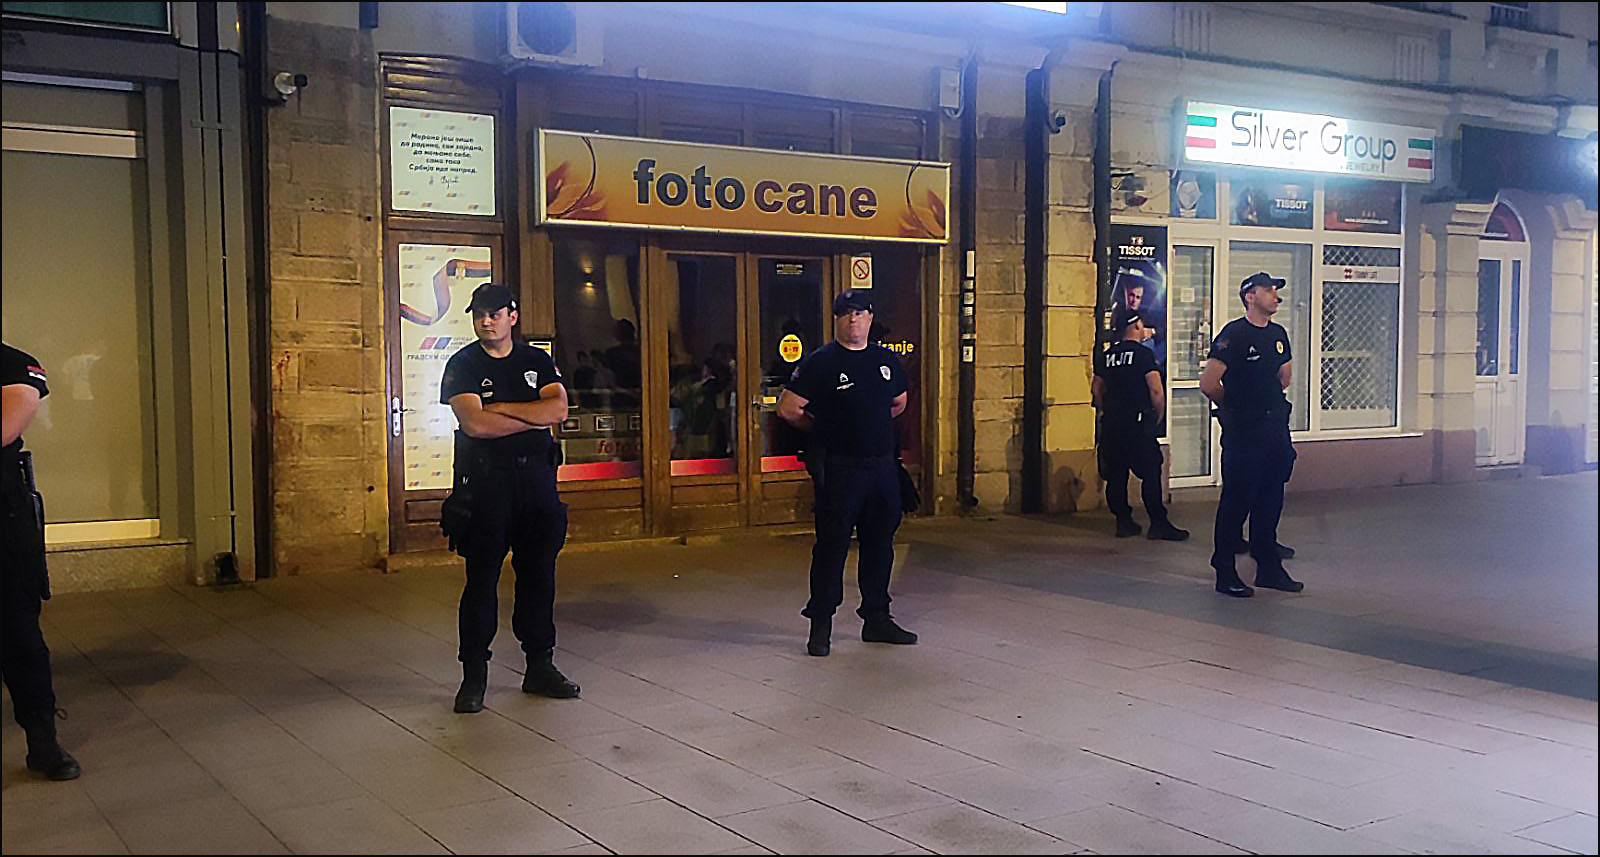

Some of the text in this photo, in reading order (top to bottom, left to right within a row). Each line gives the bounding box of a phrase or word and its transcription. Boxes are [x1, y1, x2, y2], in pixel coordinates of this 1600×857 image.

[1231, 111, 1397, 173] Silver Group
[409, 163, 434, 172] Србија
[633, 159, 878, 219] foto cane
[1118, 245, 1156, 256] TISSOT
